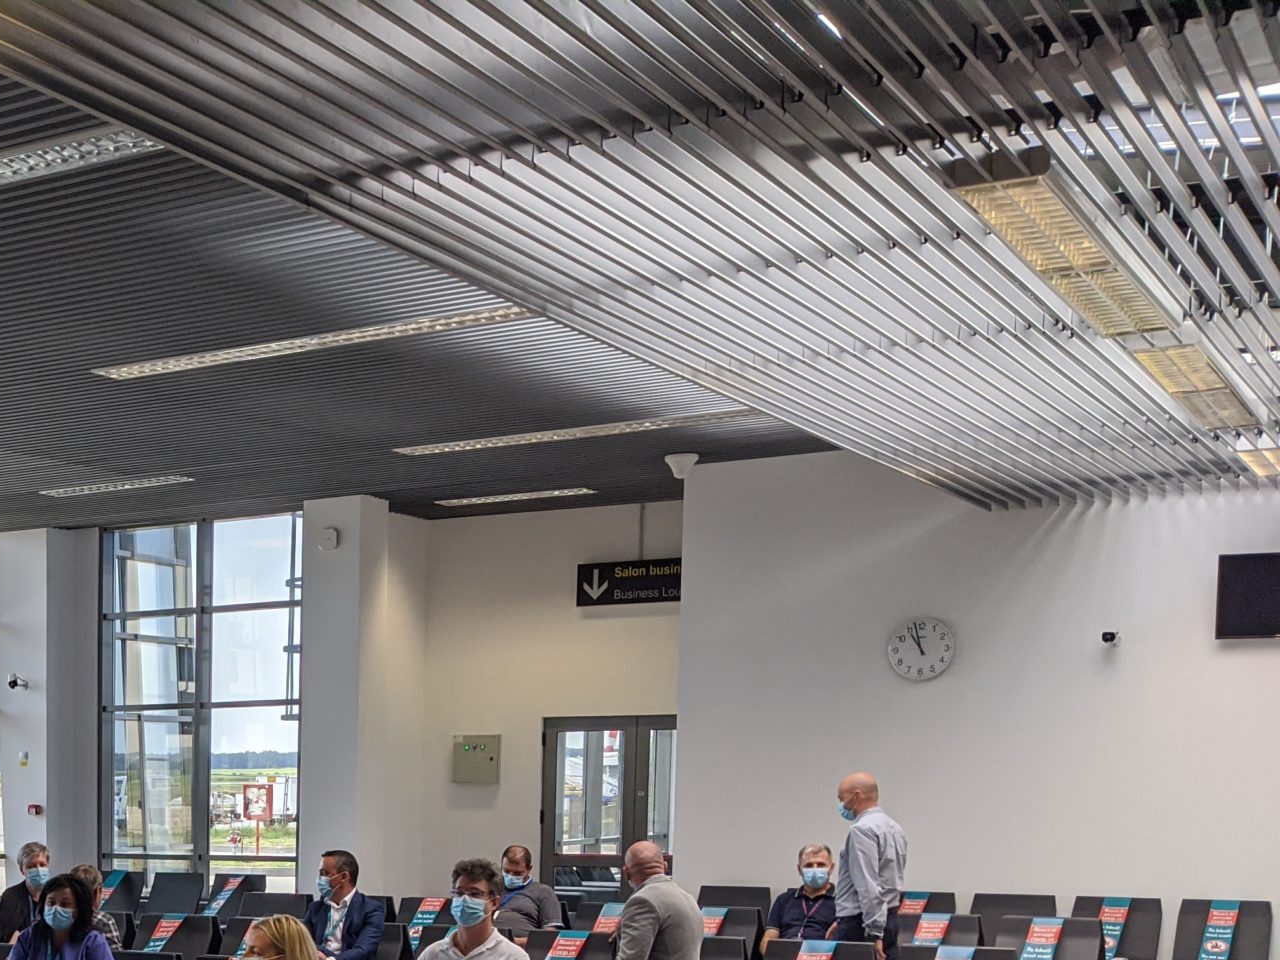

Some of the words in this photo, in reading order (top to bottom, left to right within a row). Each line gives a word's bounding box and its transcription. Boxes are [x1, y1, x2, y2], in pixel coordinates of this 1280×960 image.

[614, 566, 646, 578] Salon
[649, 564, 680, 575] busin
[614, 588, 659, 599] Business
[662, 587, 680, 597] Lou
[940, 632, 945, 640] 2
[944, 644, 949, 652] 3
